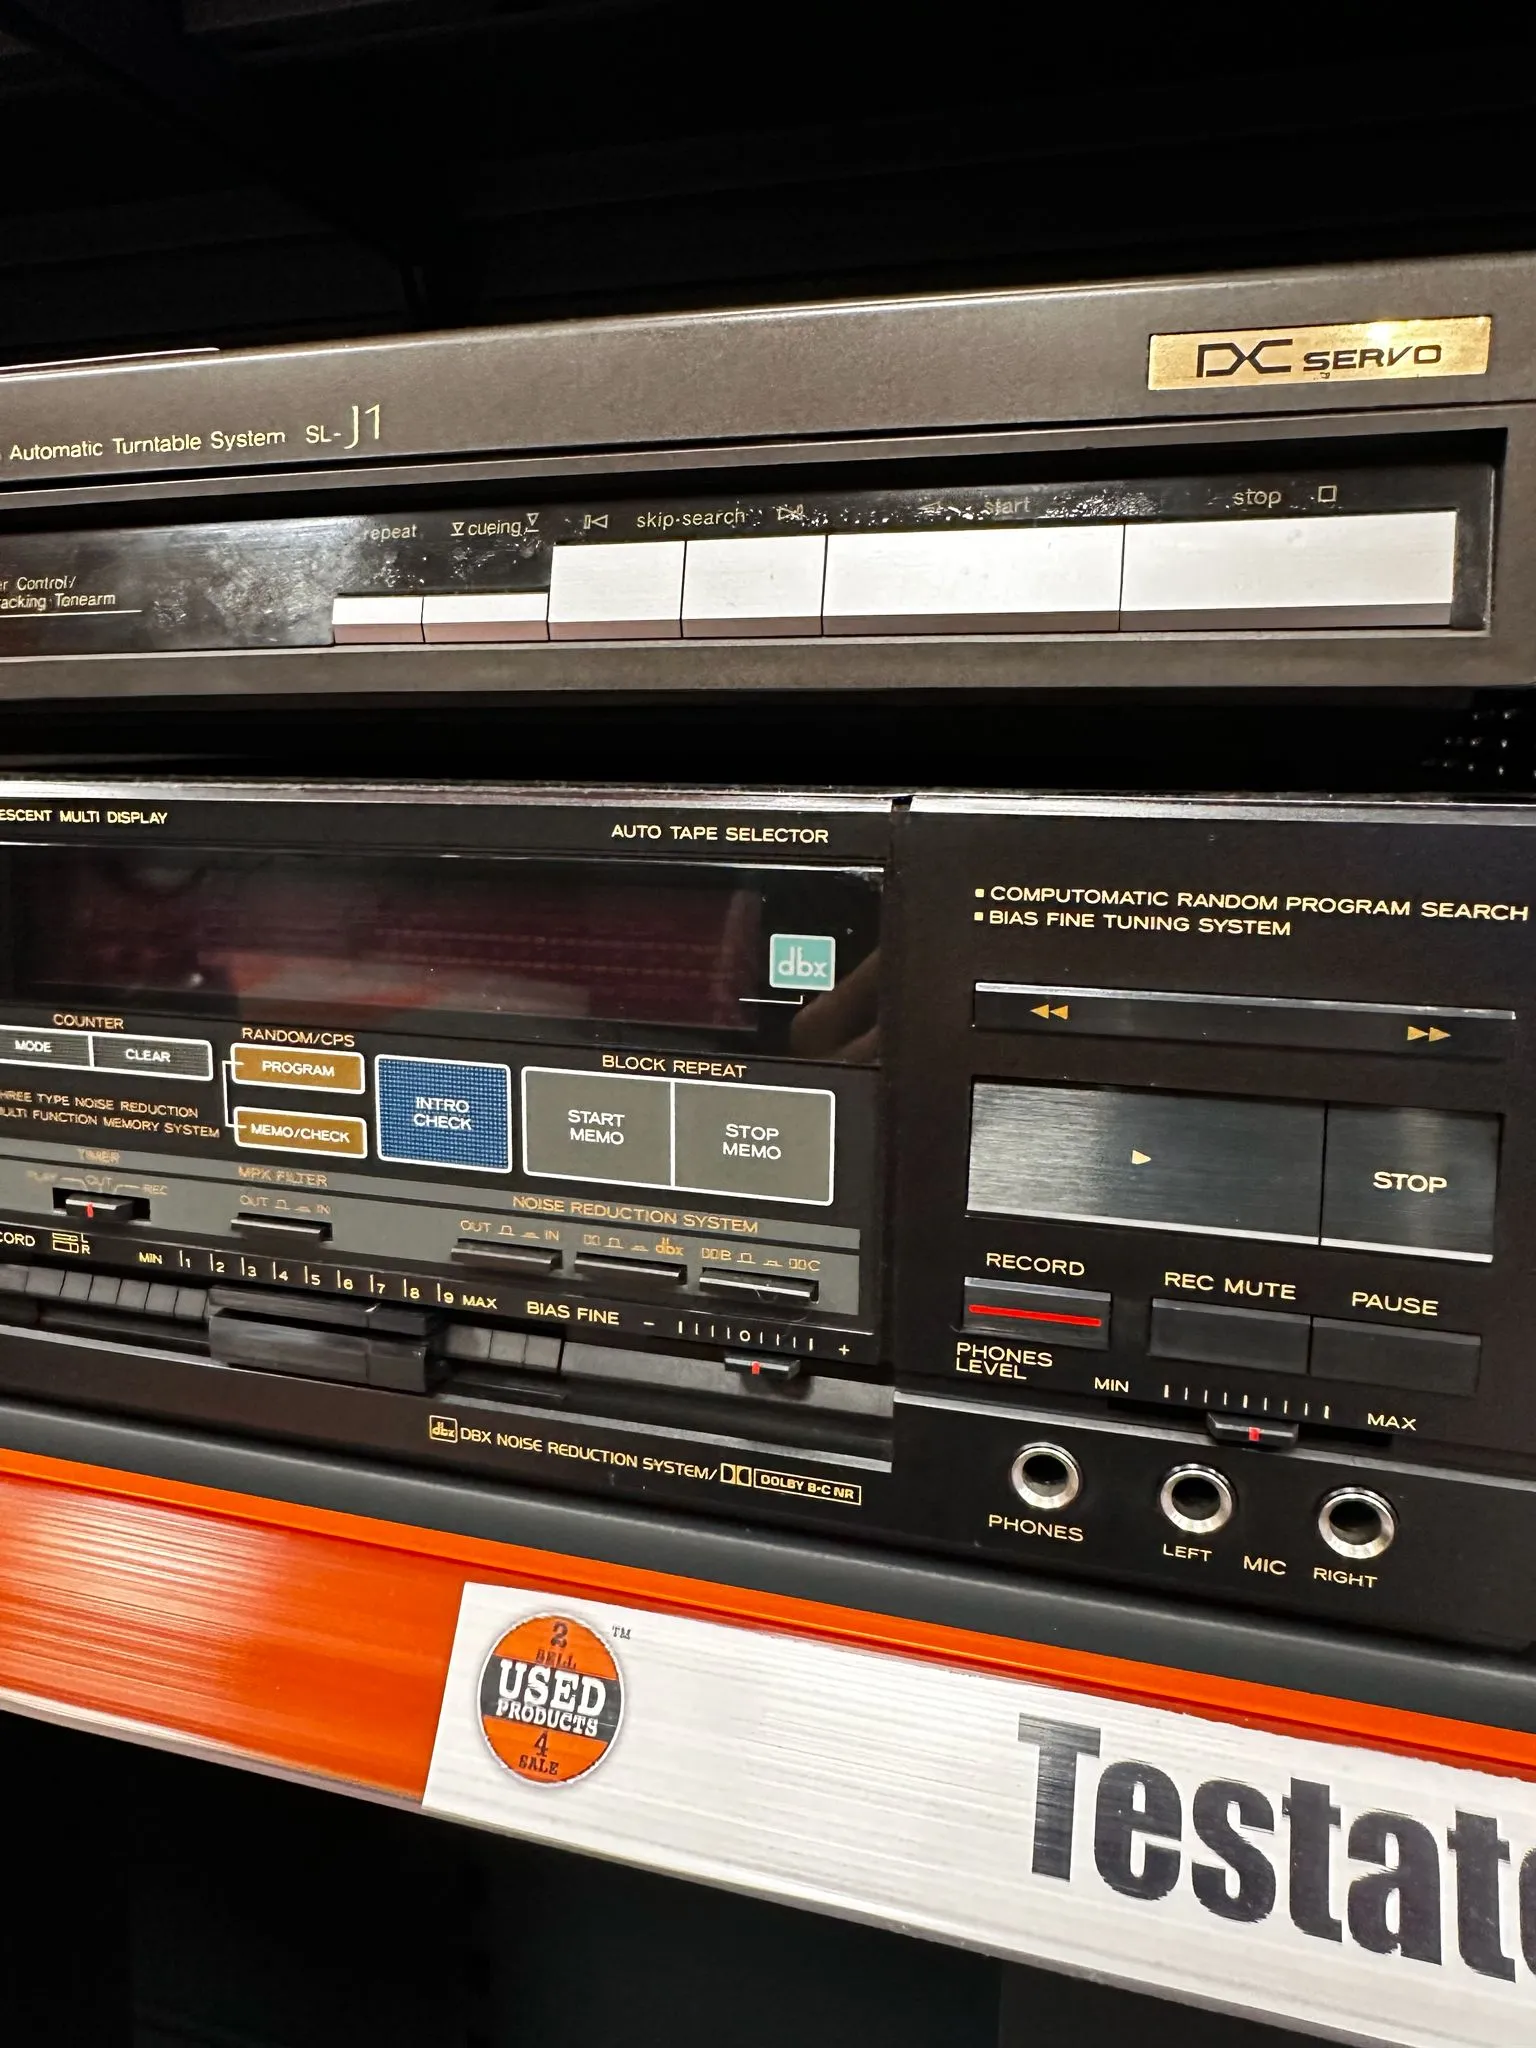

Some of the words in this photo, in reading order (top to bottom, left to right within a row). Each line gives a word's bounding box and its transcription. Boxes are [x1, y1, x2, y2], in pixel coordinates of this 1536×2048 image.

[1303, 344, 1442, 371] SERVO
[9, 442, 104, 460] Automatic
[111, 432, 202, 455] Turntable
[210, 430, 286, 450] System
[984, 497, 1031, 515] start
[1232, 488, 1282, 509] stop
[363, 524, 417, 542] repeat
[468, 519, 522, 537] cueing
[54, 592, 117, 607] Tonearm
[0, 808, 53, 822] ESCENT
[59, 810, 100, 823] MULTI
[107, 811, 168, 824] DISPLAY
[611, 824, 662, 839] AUTO
[670, 825, 718, 841] TAPE
[725, 826, 829, 843] SELECTOR
[990, 886, 1169, 907] COMPUTOMATIC
[1177, 891, 1278, 911] RANDOM
[1286, 896, 1411, 916] PROGRAM
[1421, 901, 1529, 922] SEARCH
[989, 910, 1039, 926] BIAS
[1047, 912, 1095, 928] FINE
[1103, 914, 1190, 932] TUNING
[1198, 918, 1291, 936] SYSTEM
[778, 946, 828, 978] dbx
[53, 1014, 124, 1030] COUNTER
[15, 1040, 52, 1053] MODE
[242, 1028, 356, 1048] RANDOM/CPS
[125, 1048, 171, 1063] CLEAR
[262, 1060, 336, 1077] PROGRAM
[602, 1055, 666, 1072] BLOCK
[673, 1060, 747, 1079] REPEAT
[37, 1093, 70, 1106] TYPE
[75, 1097, 114, 1110] NOISE
[120, 1101, 199, 1119] REDUCTION
[416, 1097, 469, 1114] INTRO
[32, 1109, 98, 1126] FUNCTION
[103, 1117, 160, 1132] MEMORY
[164, 1122, 220, 1138] SYSTEM
[414, 1113, 472, 1131] CHECK
[568, 1110, 625, 1128] START
[251, 1123, 351, 1144] MEMO/CHECK
[570, 1128, 624, 1145] MEMO
[725, 1124, 779, 1142] STOP
[78, 1148, 121, 1164] TIMER
[722, 1143, 782, 1161] MEMO
[142, 1183, 169, 1196] REC
[276, 1170, 328, 1188] FILTER
[1374, 1171, 1447, 1194] STOP
[240, 1194, 270, 1207] OUT
[316, 1204, 331, 1215] IN
[512, 1196, 565, 1213] NOISE
[570, 1201, 677, 1225] REDUCTION
[683, 1213, 759, 1234] SYSTEM
[81, 1232, 89, 1243] L
[460, 1219, 492, 1233] OUT
[545, 1229, 560, 1241] IN
[82, 1244, 91, 1255] R
[655, 1236, 685, 1257] dbx
[986, 1252, 1085, 1275] RECORD
[138, 1252, 163, 1265] MIN
[216, 1261, 225, 1273] 2
[248, 1266, 257, 1278] 3
[279, 1269, 289, 1281] 4
[311, 1274, 321, 1287] 5
[343, 1278, 353, 1290] 6
[376, 1283, 386, 1295] 7
[410, 1287, 420, 1299] 8
[443, 1292, 454, 1304] 9
[462, 1294, 498, 1310] MAX
[1164, 1271, 1214, 1291] REC
[1223, 1278, 1297, 1300] MUTE
[527, 1300, 570, 1319] BIAS
[577, 1307, 620, 1326] FINE
[1351, 1291, 1439, 1316] PAUSE
[956, 1342, 1053, 1367] PHONES
[955, 1357, 1027, 1380] LEVEL
[1094, 1376, 1129, 1393] MIN
[1367, 1412, 1417, 1431] MAX
[431, 1421, 456, 1439] dbx
[460, 1427, 492, 1445] DBX
[496, 1433, 543, 1453] NOISE
[548, 1441, 638, 1468] REDUCTION
[642, 1457, 717, 1481] SYSTEM/
[760, 1474, 804, 1491] DOLBY
[833, 1487, 854, 1500] NR
[988, 1514, 1084, 1542] PHONES
[1163, 1543, 1212, 1562] LEFT
[1243, 1555, 1287, 1575] MIC
[1313, 1567, 1378, 1588] RIGHT
[550, 1621, 568, 1648] 2
[611, 1625, 631, 1640] TM
[498, 1658, 607, 1717] USED
[496, 1699, 598, 1736] PRODUCTS
[534, 1730, 549, 1758] 4
[519, 1755, 559, 1775] SALE
[1018, 1711, 1536, 1984] Testat
